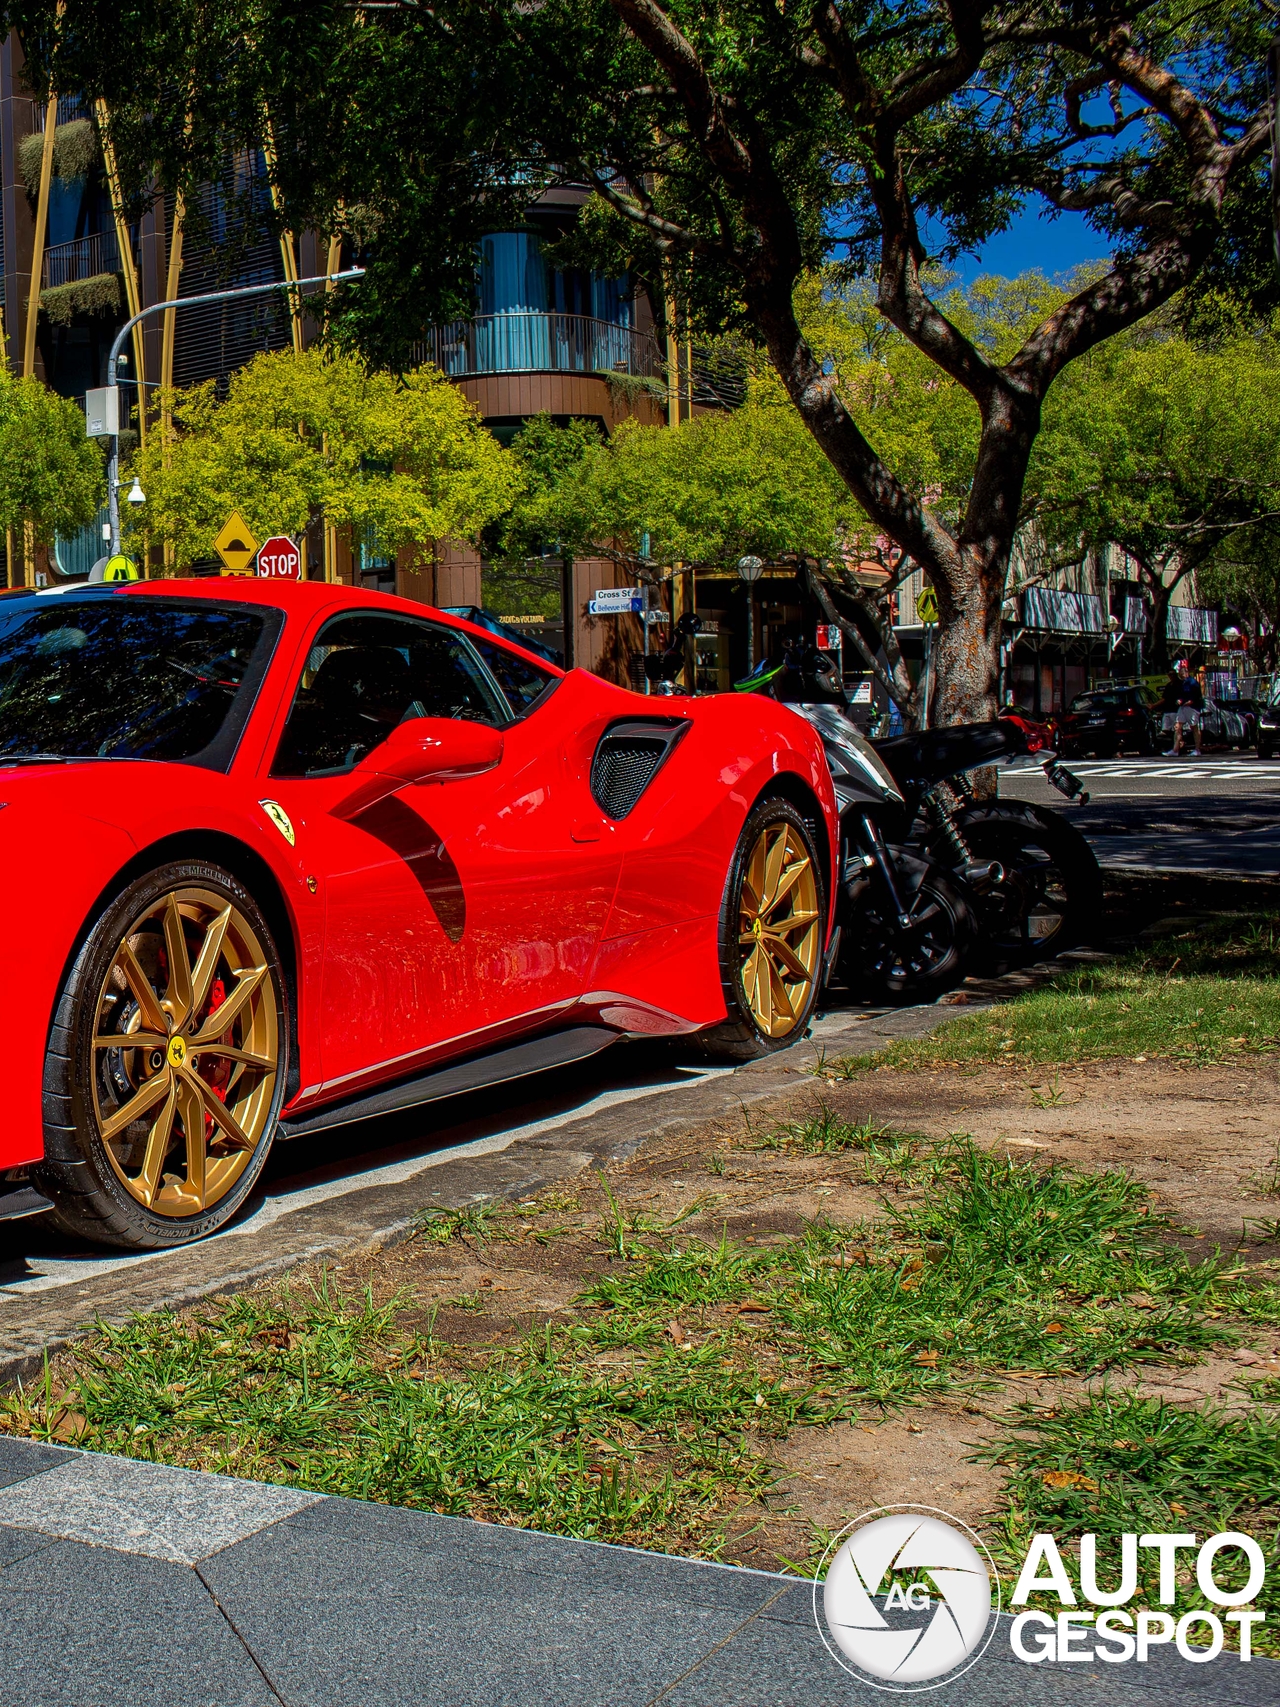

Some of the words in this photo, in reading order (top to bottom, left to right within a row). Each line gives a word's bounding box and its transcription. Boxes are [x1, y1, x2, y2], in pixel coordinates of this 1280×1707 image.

[260, 553, 298, 578] STOP
[598, 591, 620, 599] Cross
[189, 866, 231, 888] MICHELIN
[147, 1224, 191, 1238] MICHELIN
